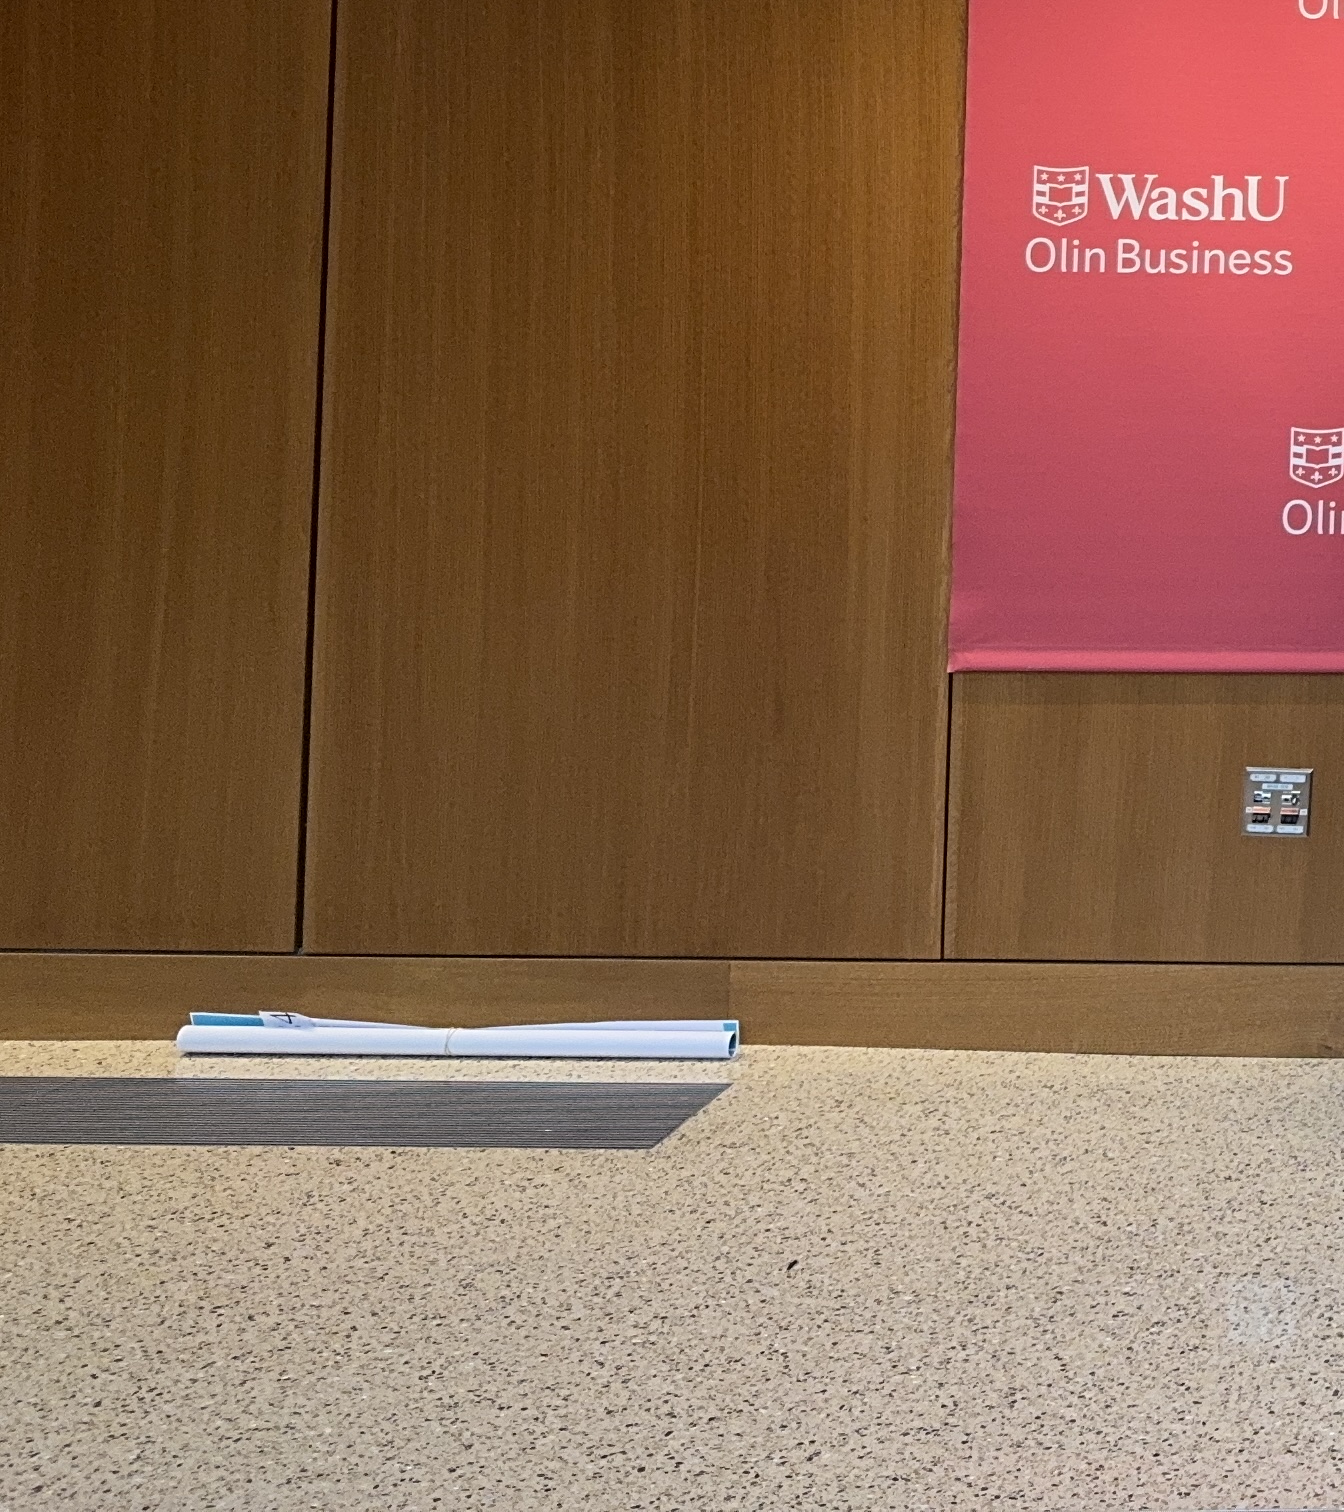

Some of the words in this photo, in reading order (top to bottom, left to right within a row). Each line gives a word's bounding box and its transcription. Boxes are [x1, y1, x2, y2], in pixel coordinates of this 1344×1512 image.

[1095, 173, 1290, 222] WashU
[1025, 236, 1106, 273] Olin
[1116, 238, 1293, 276] Business
